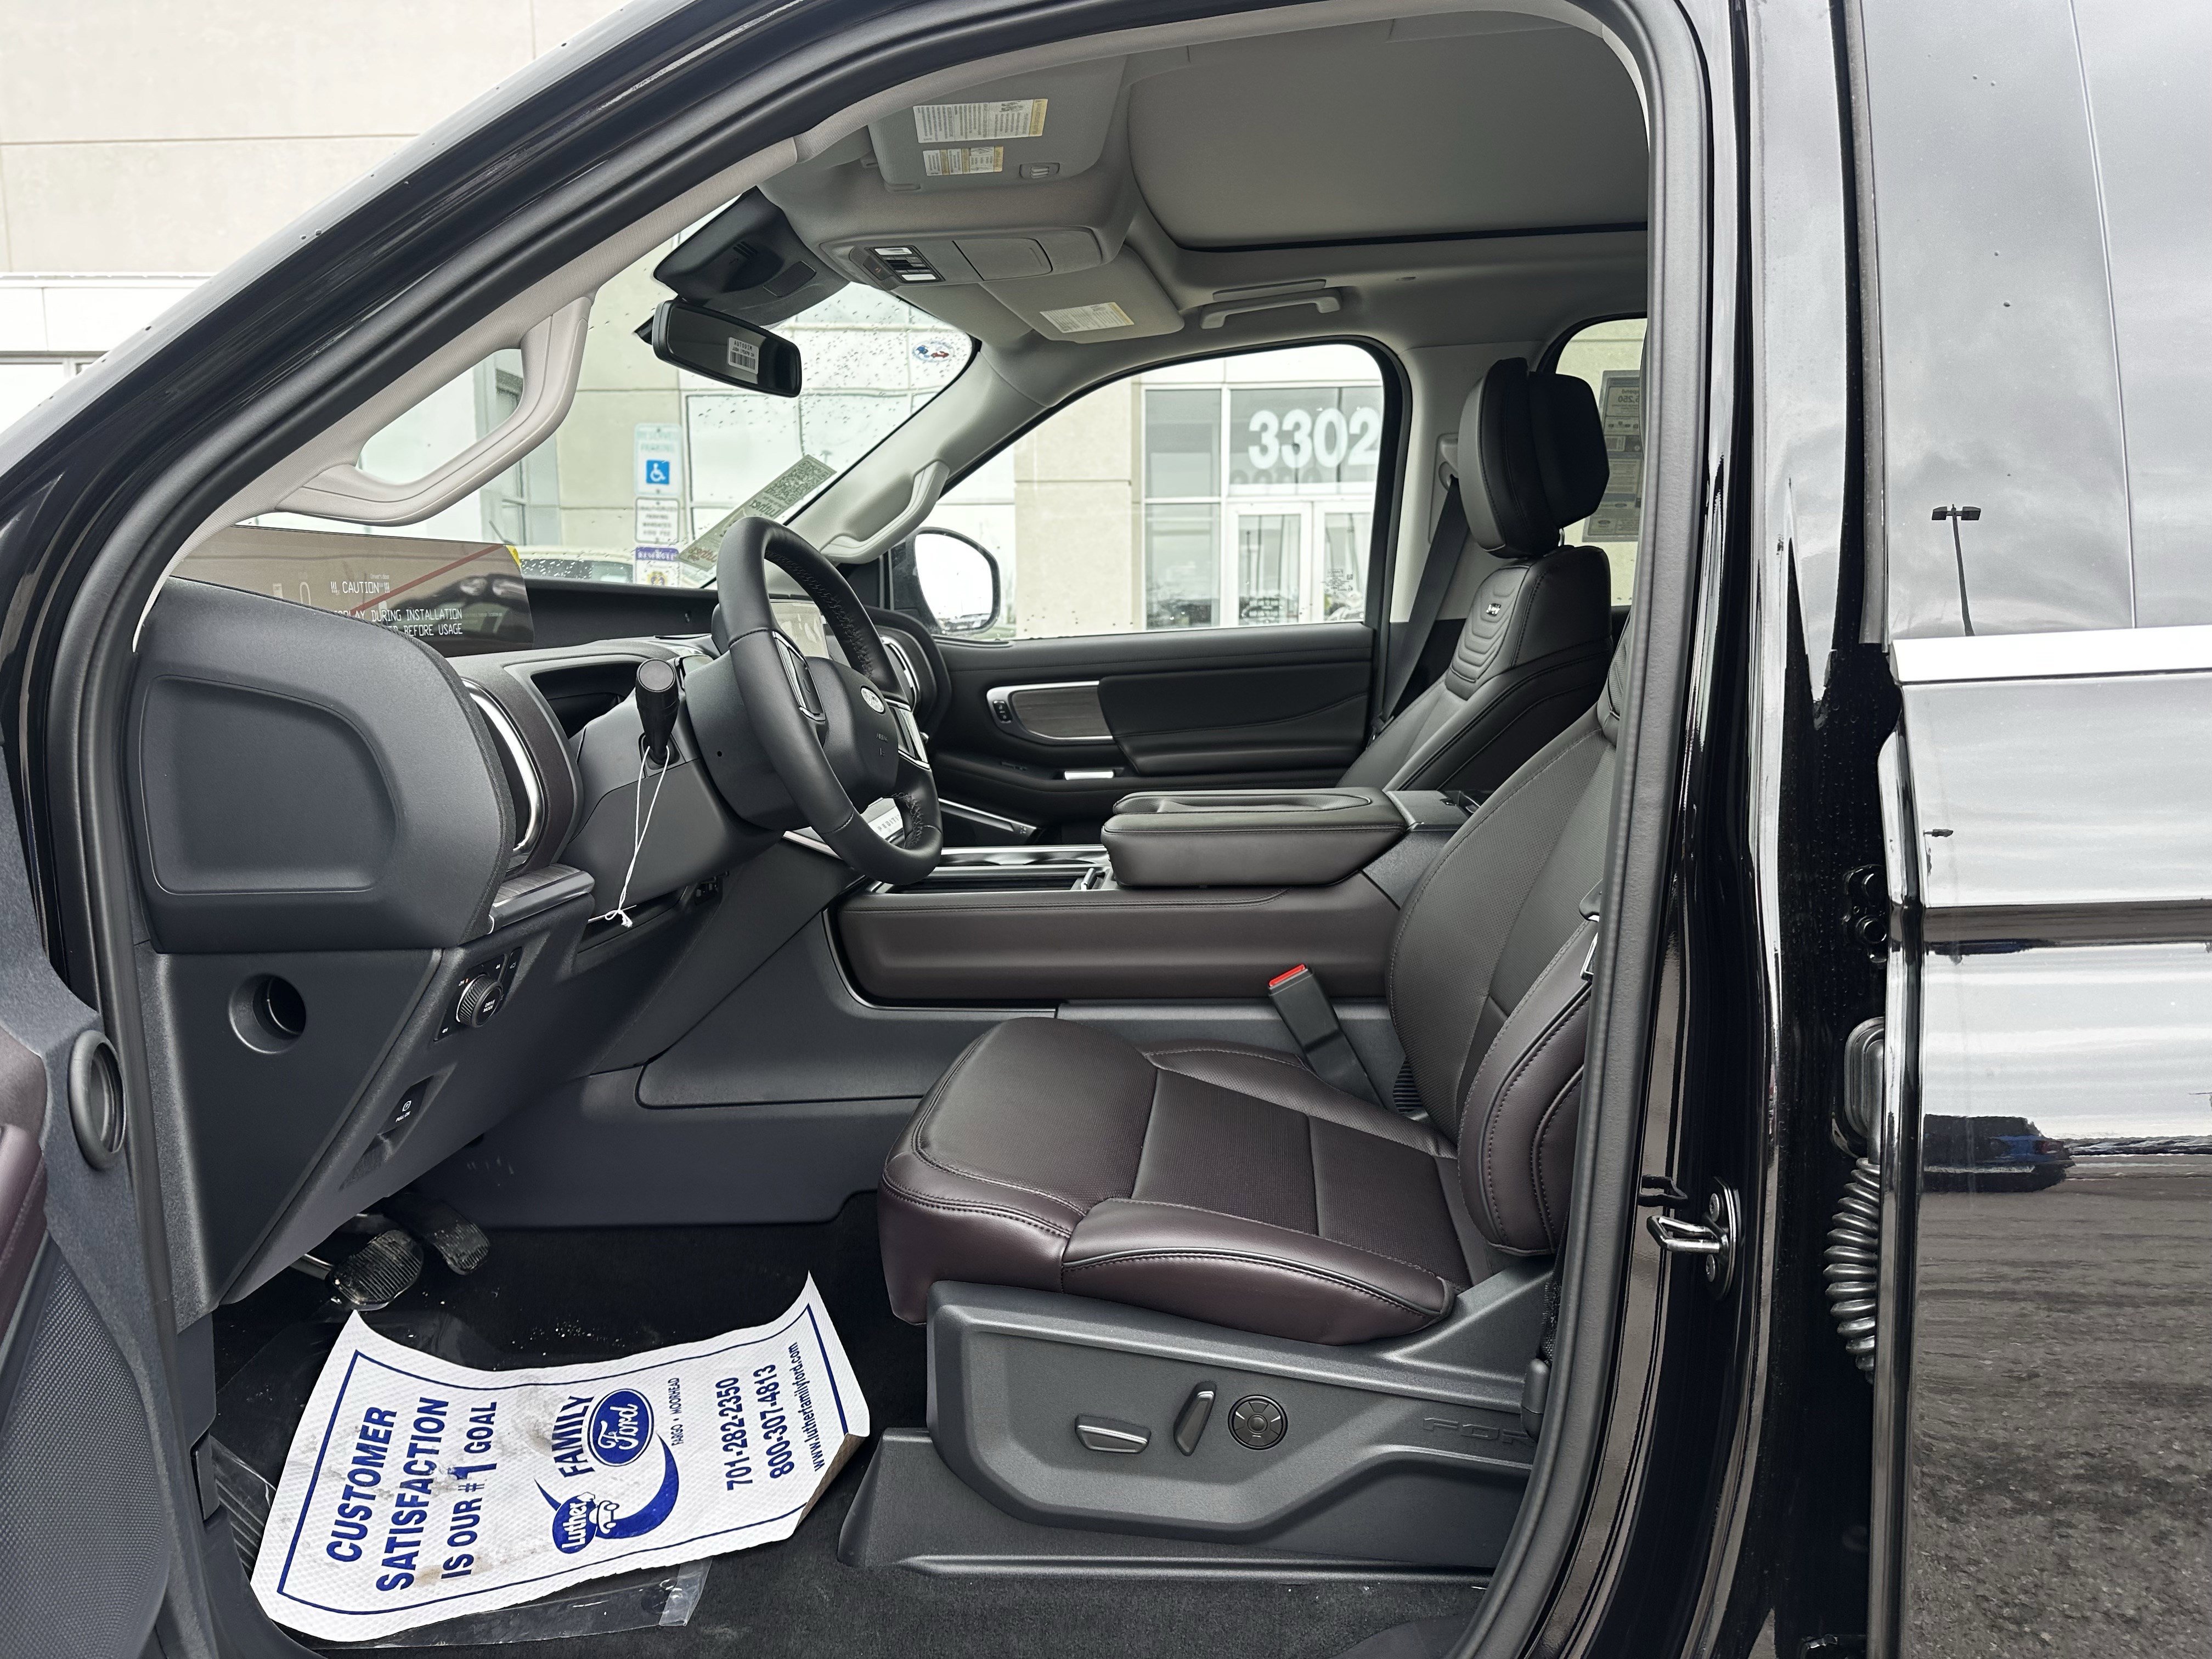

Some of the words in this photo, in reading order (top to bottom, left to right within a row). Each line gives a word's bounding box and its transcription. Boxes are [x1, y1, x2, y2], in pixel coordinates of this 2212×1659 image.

[734, 340, 752, 351] AUTODIM
[1248, 407, 1382, 469] 3302
[342, 582, 379, 594] CAUTION
[371, 609, 402, 622] DURING
[406, 608, 462, 621] INSTALLATION
[403, 624, 435, 636] BEFORE
[438, 623, 463, 635] USAGE
[668, 1378, 682, 1415] MOORHEAD
[788, 1342, 825, 1472] www.lutherfamilyford.com
[464, 1402, 497, 1454] GOAL
[552, 1396, 595, 1477] FAMILY
[598, 1404, 638, 1450] Ford
[670, 1424, 684, 1446] FARGO
[715, 1377, 753, 1491] 701-282-2350
[753, 1364, 794, 1479] 800-307-4813
[1423, 1418, 1534, 1446] FOR
[326, 1407, 397, 1562] CUSTOMER
[376, 1397, 449, 1591] SATISFACTION
[447, 1497, 482, 1547] OUR
[562, 1502, 587, 1548] Luther
[441, 1554, 474, 1579] IS
